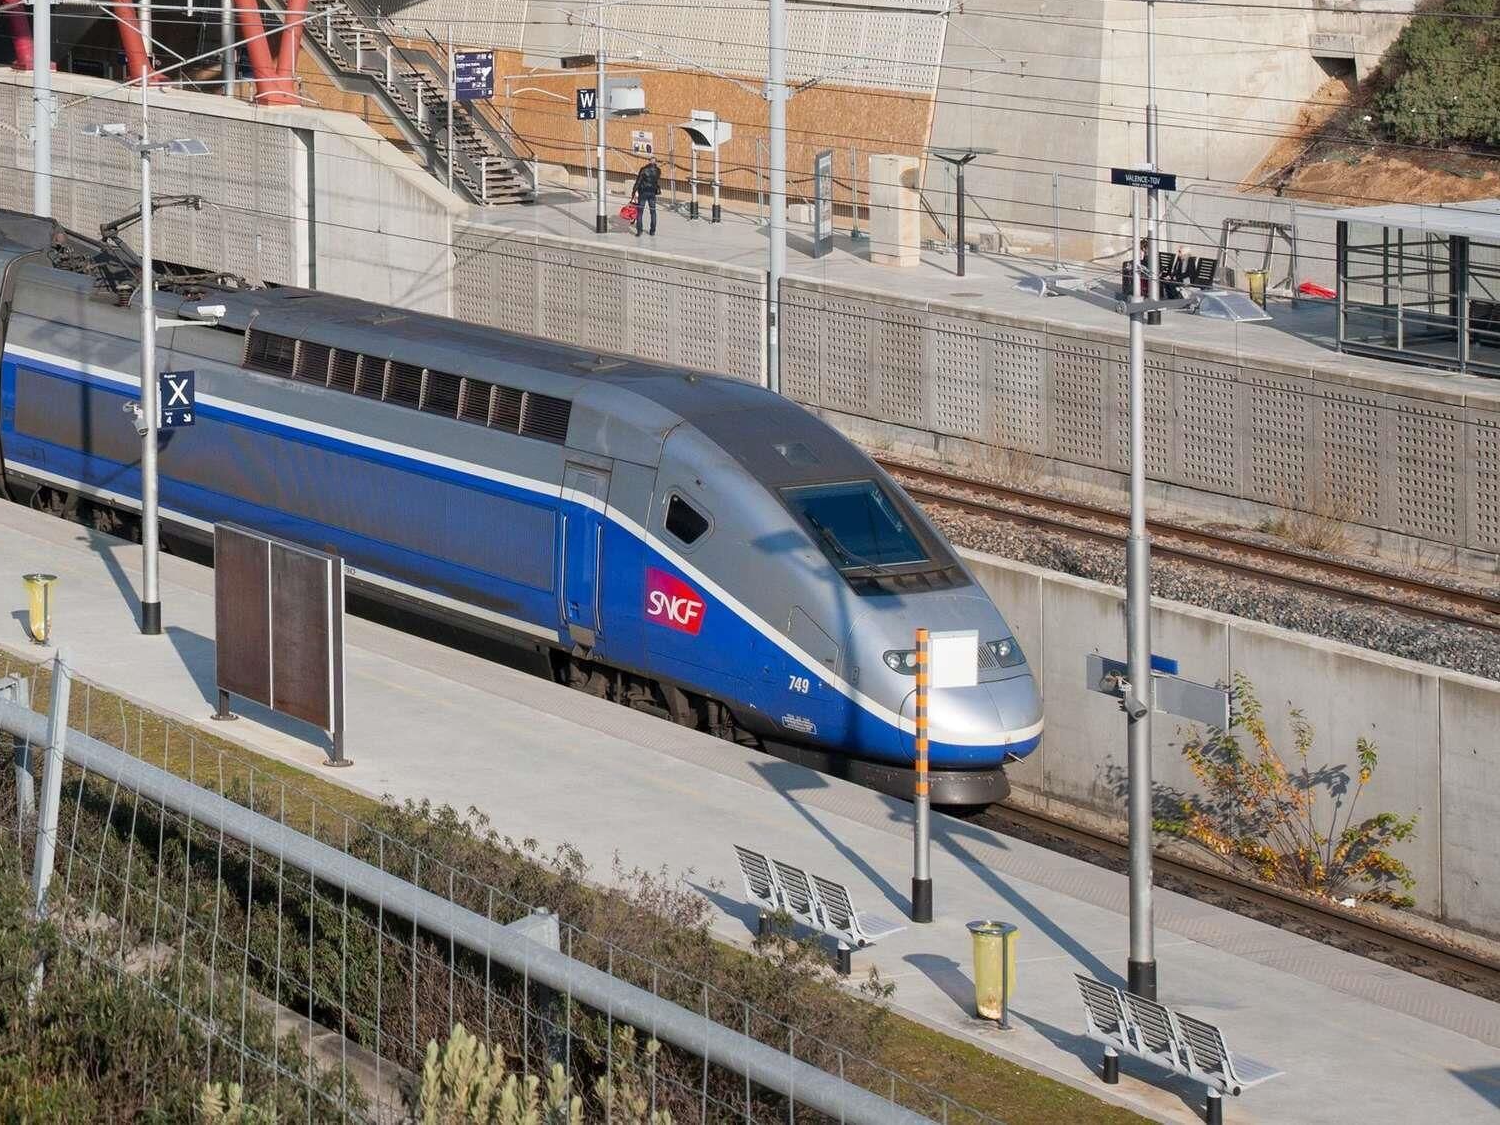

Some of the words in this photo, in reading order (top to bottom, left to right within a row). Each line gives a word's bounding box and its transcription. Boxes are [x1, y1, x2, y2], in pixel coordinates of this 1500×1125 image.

[580, 93, 594, 108] W
[1125, 174, 1161, 185] VALENCE-TGV
[168, 379, 189, 405] X
[647, 590, 703, 625] SNCF
[788, 675, 809, 693] 749
